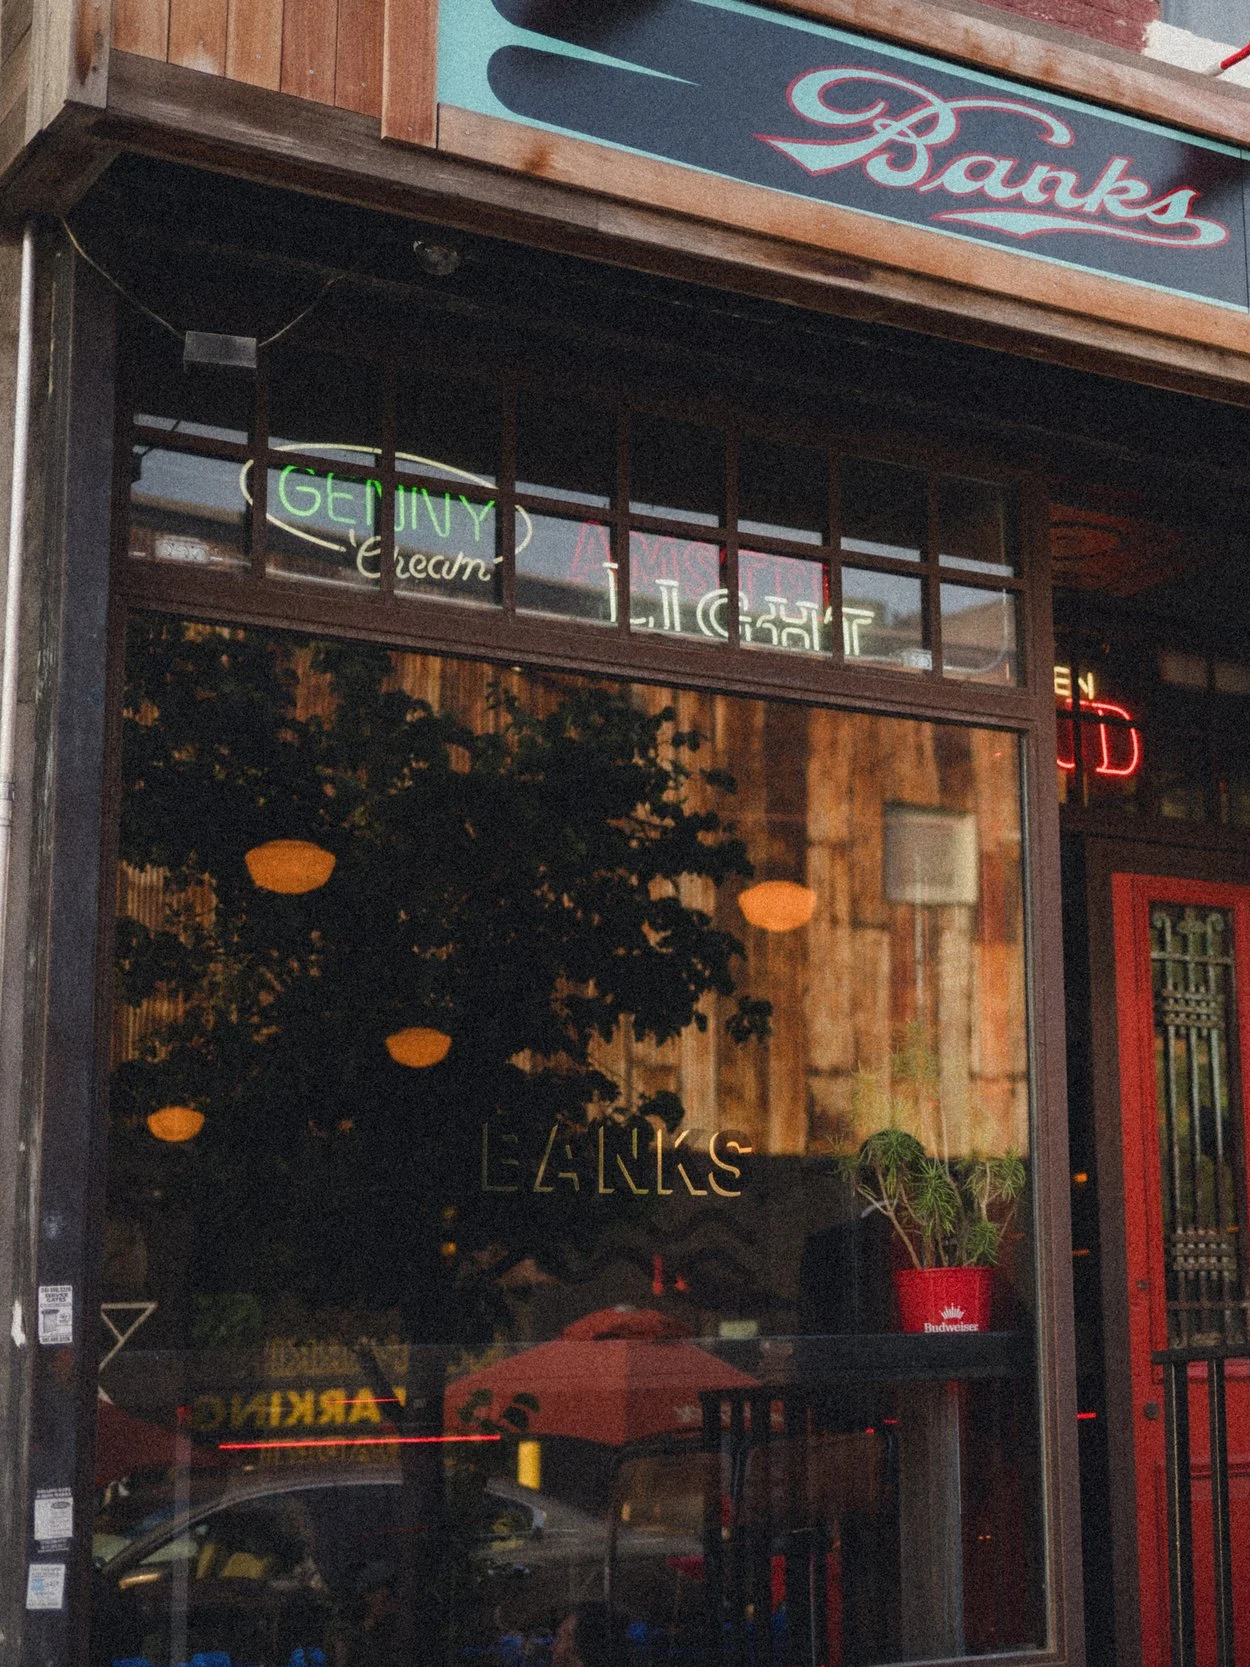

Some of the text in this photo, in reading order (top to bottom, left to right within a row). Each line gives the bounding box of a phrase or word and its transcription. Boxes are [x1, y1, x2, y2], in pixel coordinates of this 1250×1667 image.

[755, 66, 1229, 247] Banks
[277, 464, 496, 542] GENNY
[924, 1322, 979, 1333] Budweiser
